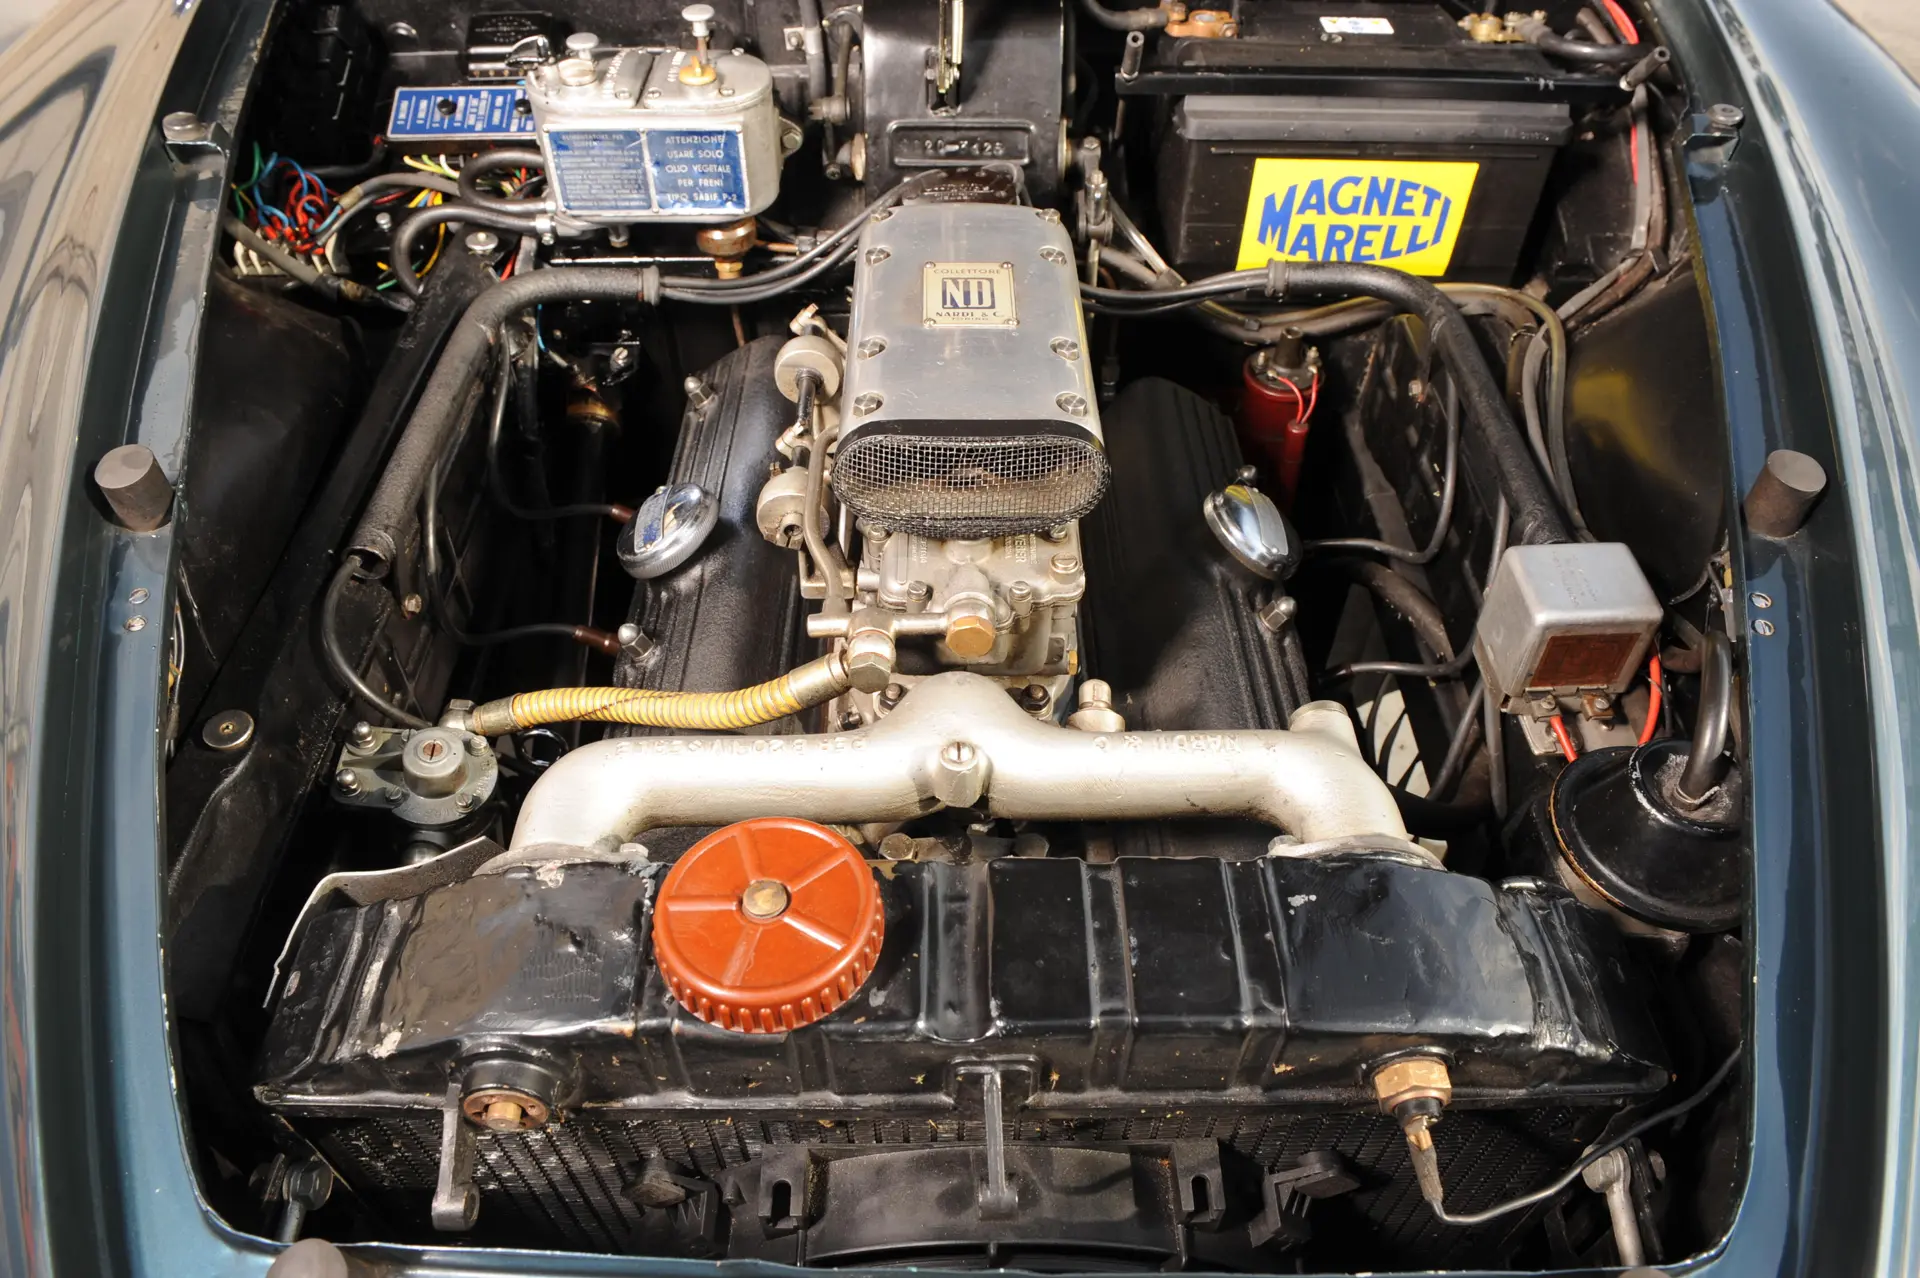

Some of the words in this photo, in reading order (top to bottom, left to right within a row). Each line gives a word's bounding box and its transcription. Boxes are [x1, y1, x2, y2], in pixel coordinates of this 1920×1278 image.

[665, 135, 724, 144] ATTENZIONE
[667, 150, 694, 159] USARE
[697, 149, 724, 158] SOLO
[665, 164, 688, 173] OLIO
[691, 164, 731, 173] VEGETALE
[677, 178, 694, 187] PER
[698, 178, 724, 187] FRENI
[666, 193, 689, 201] TIPO
[1257, 176, 1452, 232] MAGNETI
[1257, 208, 1452, 262] MARELLI
